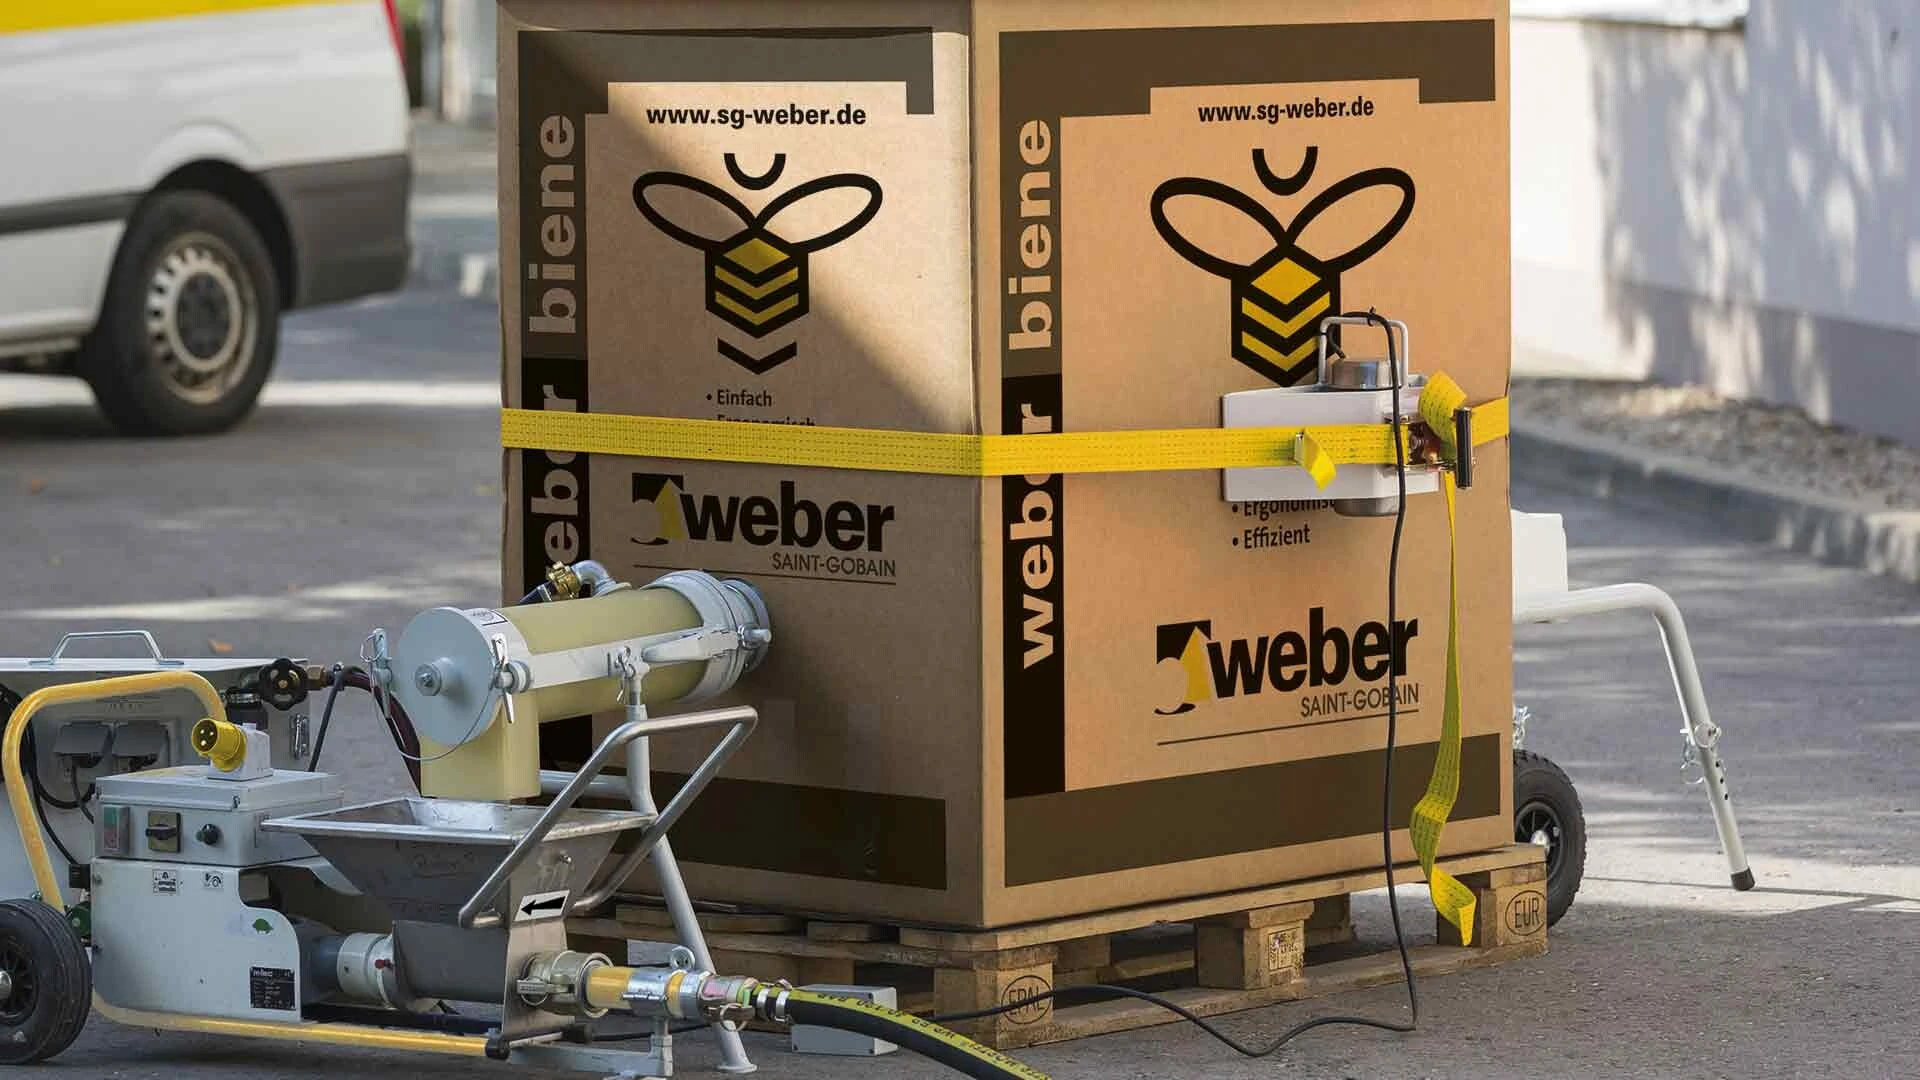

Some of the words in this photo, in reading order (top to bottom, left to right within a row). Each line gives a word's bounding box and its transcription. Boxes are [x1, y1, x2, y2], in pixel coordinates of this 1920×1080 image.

[646, 104, 867, 129] www.sg-weber.de
[1198, 97, 1374, 124] www.sg-weber.de
[528, 114, 577, 334] biene
[1008, 119, 1052, 351] biene
[717, 389, 772, 407] Einfach
[531, 384, 579, 570] ebr
[679, 481, 895, 552] weber
[1009, 403, 1055, 670] webr
[1244, 523, 1311, 549] Effizient
[771, 552, 896, 577] SAINT-GOBAIN
[1207, 607, 1418, 699] weber
[1300, 683, 1419, 718] SAINT-GOBAIN
[1514, 898, 1541, 929] EUR
[1008, 985, 1045, 1015] EPAL
